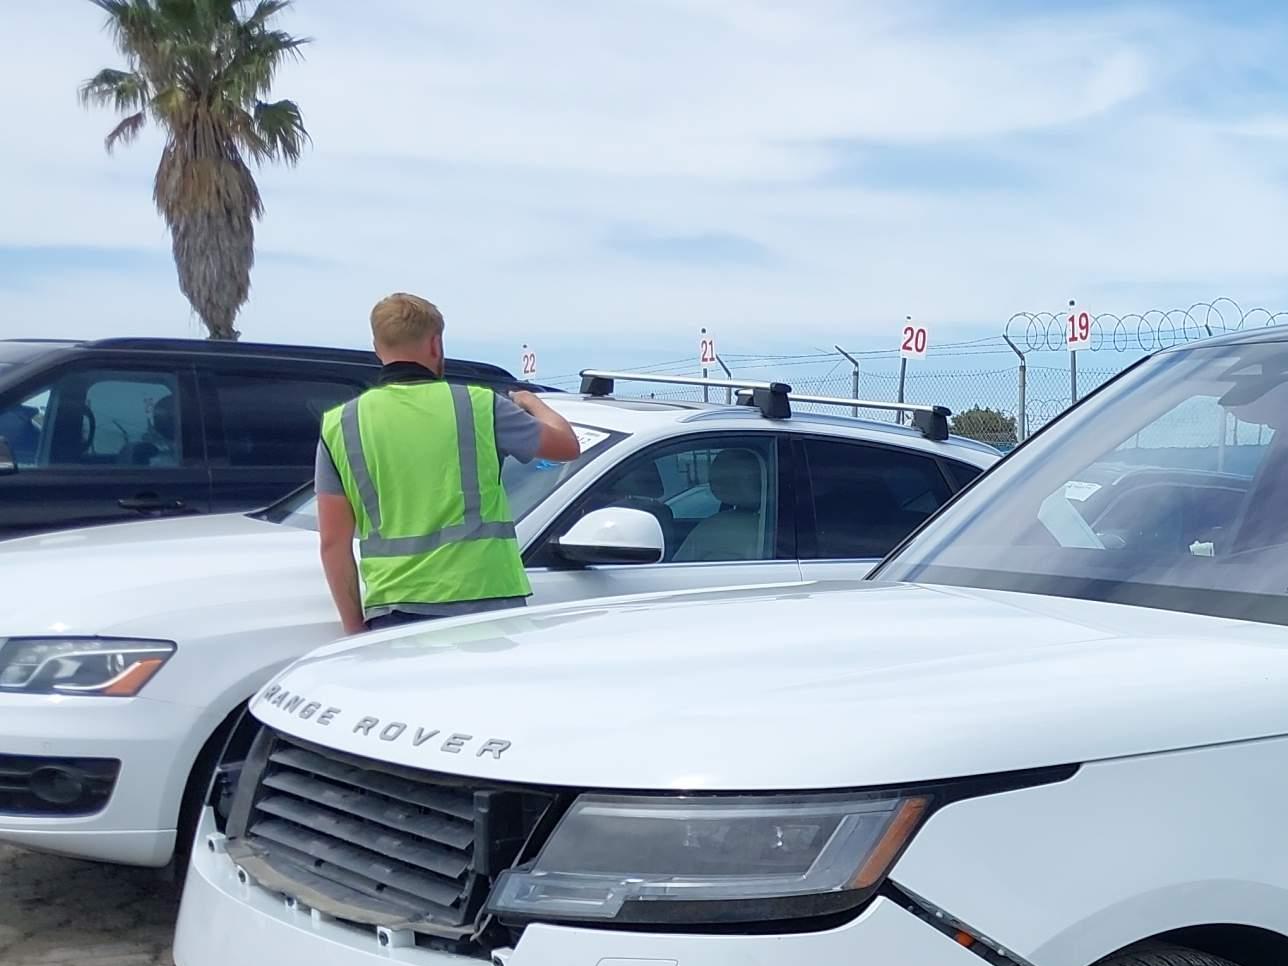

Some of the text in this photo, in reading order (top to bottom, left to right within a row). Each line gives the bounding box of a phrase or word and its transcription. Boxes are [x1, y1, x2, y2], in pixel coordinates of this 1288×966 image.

[902, 326, 926, 353] 20
[1067, 312, 1089, 343] 19
[522, 353, 536, 374] 22
[701, 340, 715, 362] 21
[264, 684, 512, 760] RANGE ROVER
